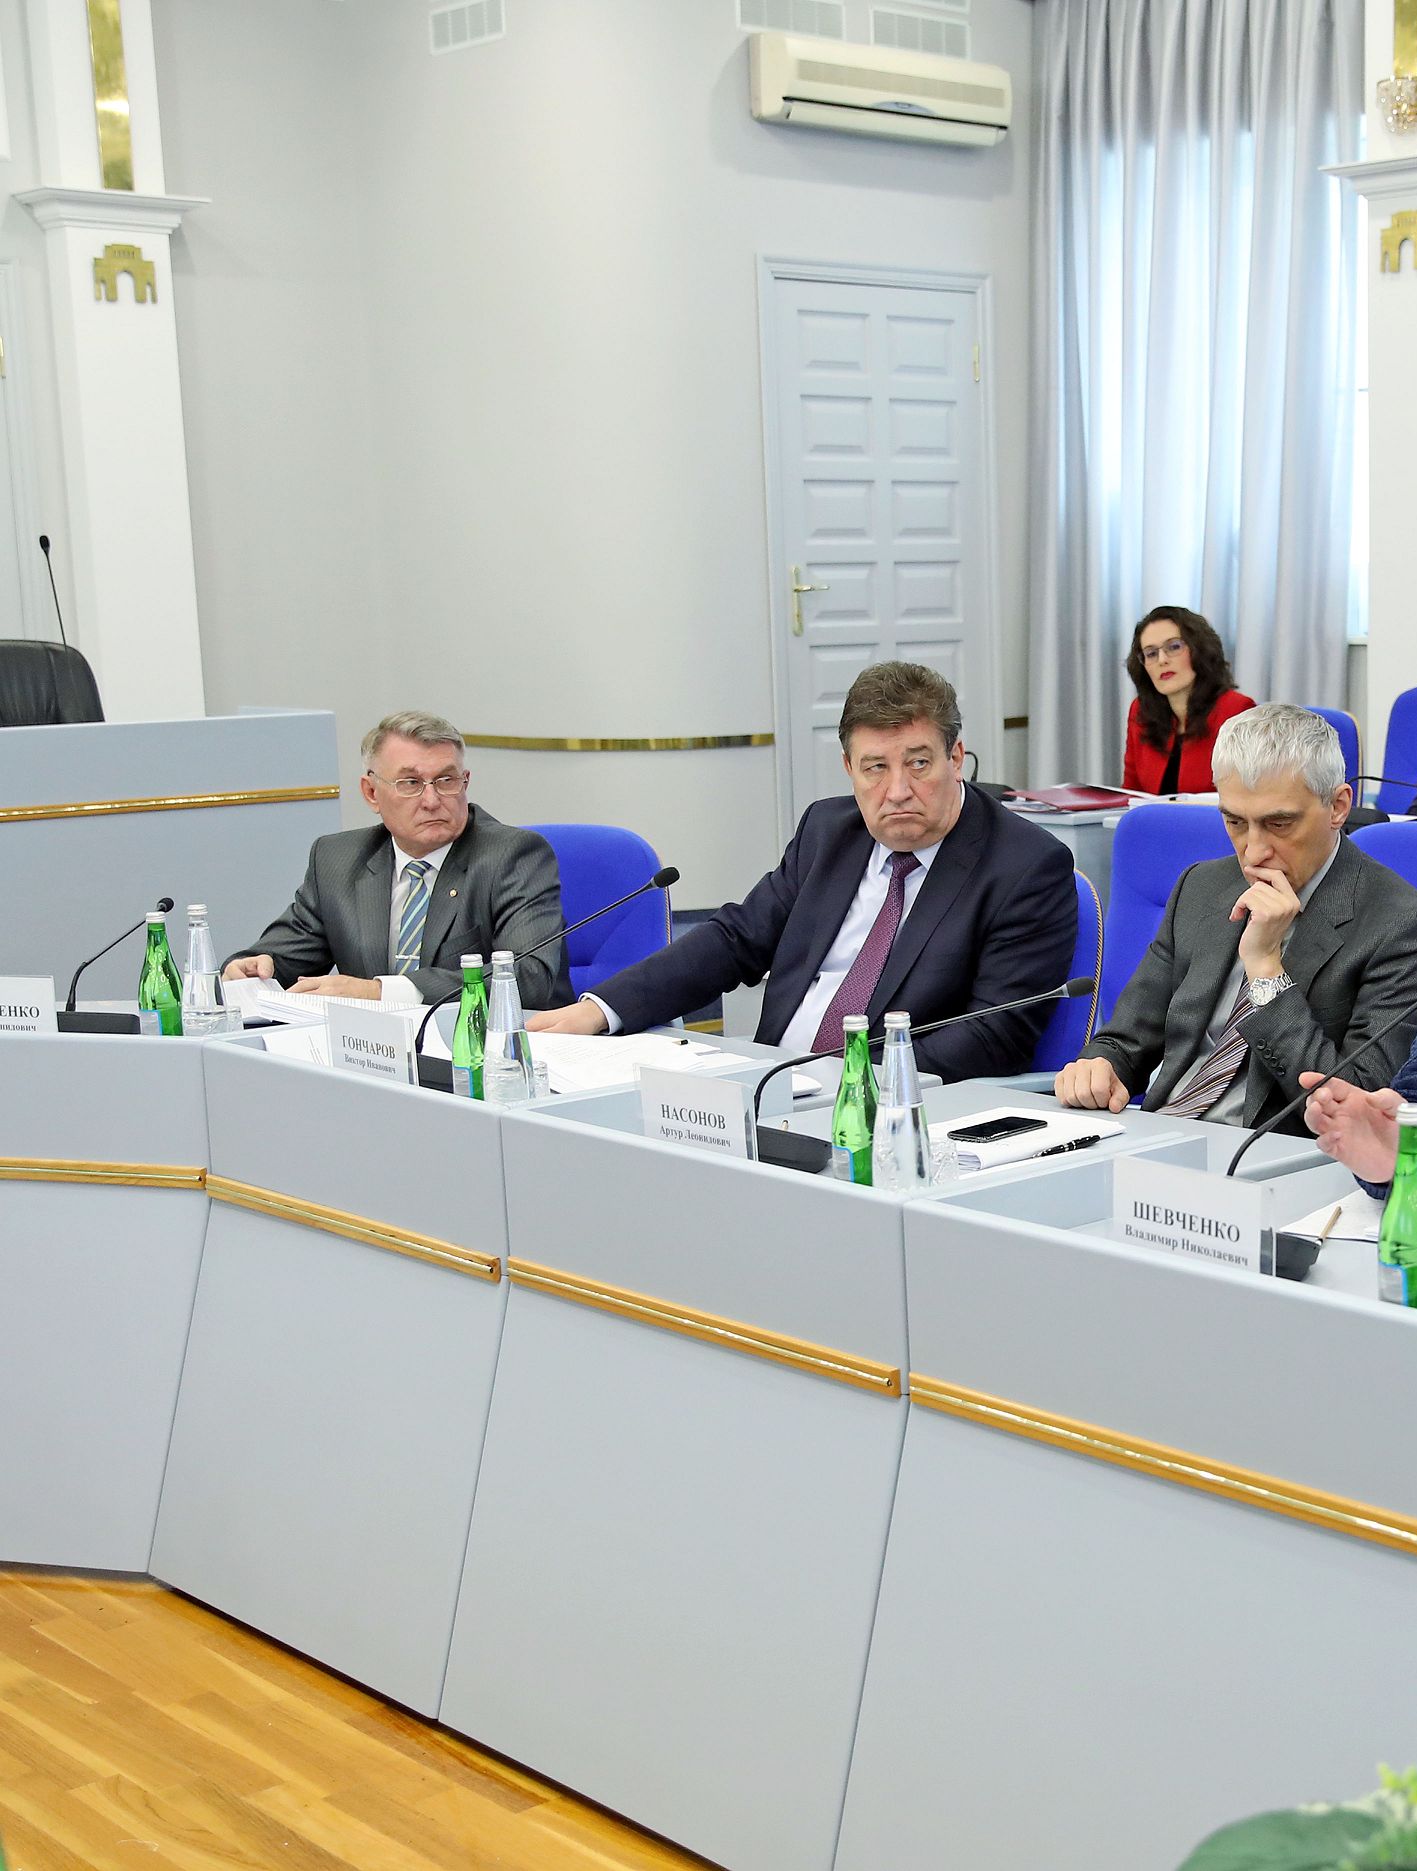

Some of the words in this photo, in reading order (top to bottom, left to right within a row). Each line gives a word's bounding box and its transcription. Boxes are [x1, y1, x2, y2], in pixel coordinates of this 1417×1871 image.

[342, 1034, 396, 1060] ГОНЧАРОВ
[344, 1053, 366, 1070] Виктор
[366, 1058, 396, 1074] Иванович
[661, 1103, 726, 1130] НАСОНОВ
[660, 1125, 683, 1141] Артур
[684, 1129, 731, 1148] Леонидович
[1133, 1200, 1240, 1243] ШЕВЧЕНКО
[1125, 1223, 1178, 1250] Владимир
[1181, 1238, 1249, 1266] Николаевич
